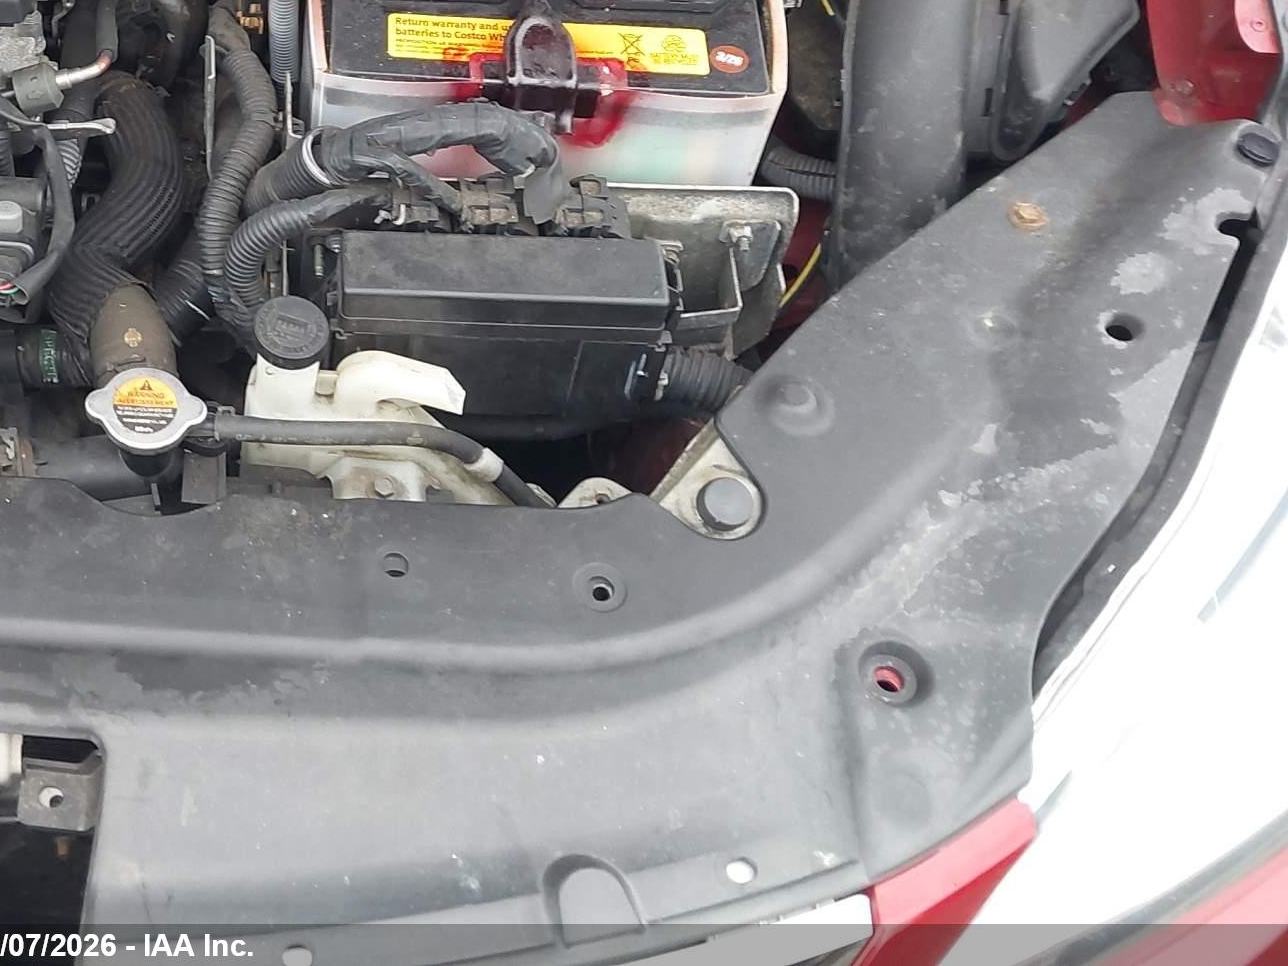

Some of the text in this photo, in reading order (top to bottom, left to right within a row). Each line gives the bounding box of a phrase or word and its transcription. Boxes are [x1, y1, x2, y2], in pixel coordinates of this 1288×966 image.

[395, 17, 429, 27] Return
[432, 20, 477, 31] warranty
[479, 23, 499, 31] and
[395, 28, 439, 37] batteries
[455, 31, 487, 40] Costco
